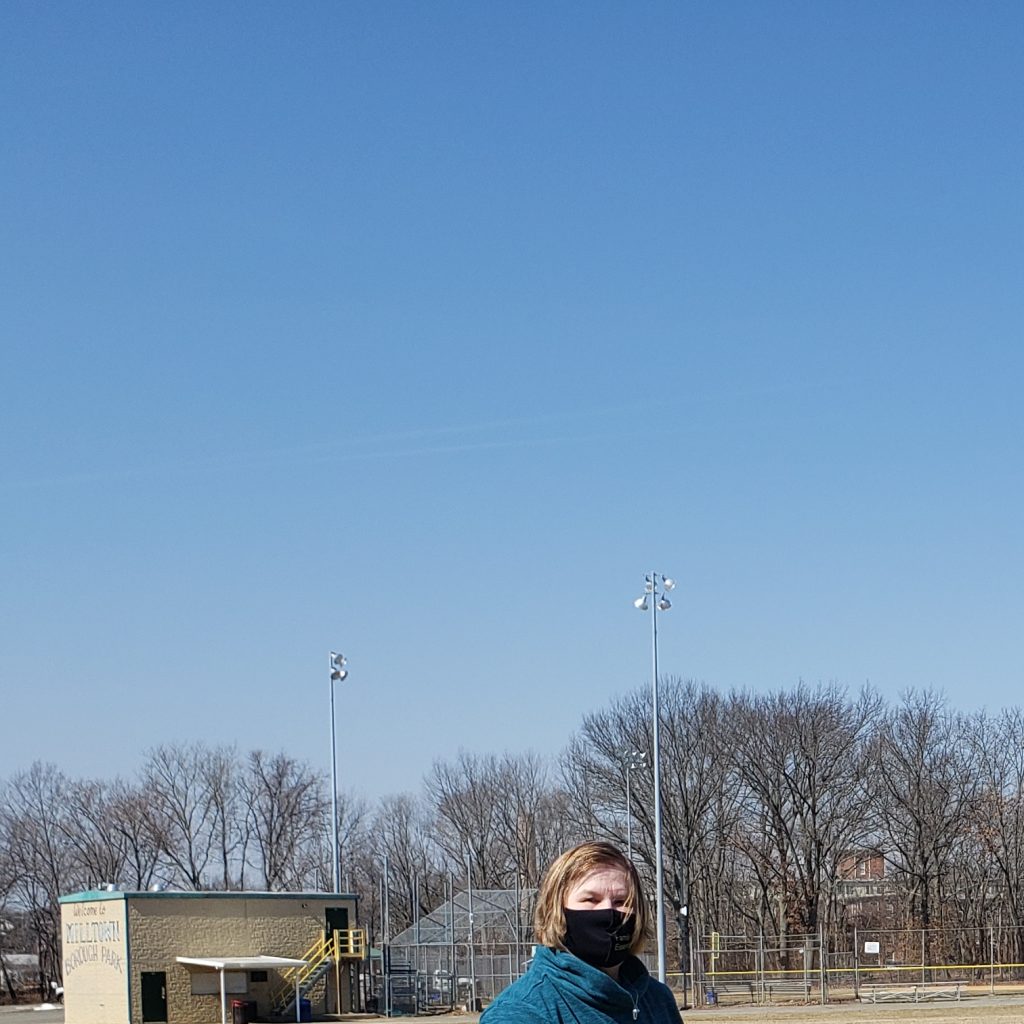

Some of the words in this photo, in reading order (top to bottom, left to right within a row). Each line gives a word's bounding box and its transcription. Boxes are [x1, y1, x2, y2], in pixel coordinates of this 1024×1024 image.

[66, 921, 120, 943] MILLTOWN
[65, 944, 98, 976] BOROUGH
[101, 946, 122, 974] PARK
